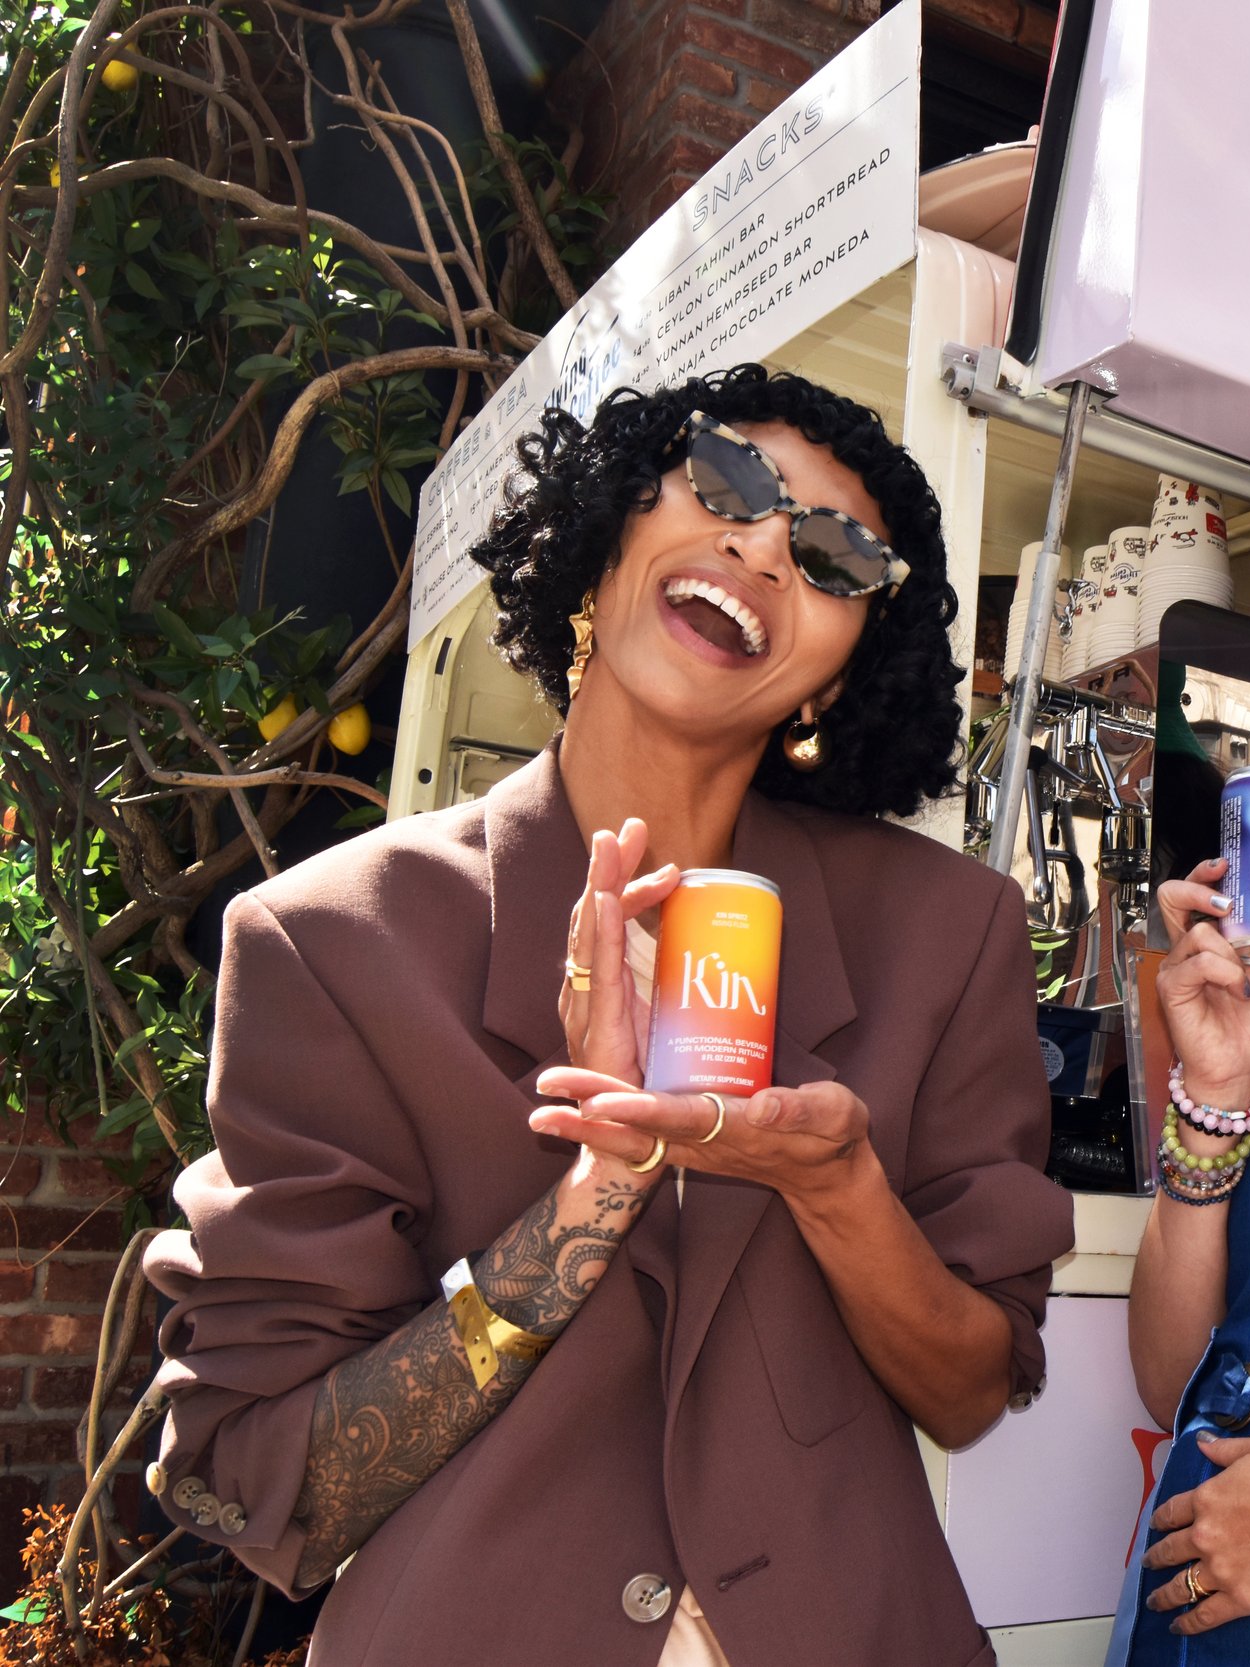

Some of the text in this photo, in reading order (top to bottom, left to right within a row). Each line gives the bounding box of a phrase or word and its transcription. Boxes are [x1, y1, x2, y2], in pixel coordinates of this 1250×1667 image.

[657, 294, 703, 339] CEYLON
[707, 232, 779, 296] CINNAMON
[784, 148, 890, 236] SHORTBREAD
[658, 276, 691, 312] LIBAN
[695, 238, 735, 279] TAHINI
[739, 213, 765, 242] BAR
[655, 229, 870, 393] GUANAJA CHOCOLATE MONEDA
[656, 323, 703, 367] YUNNAN
[706, 263, 778, 327] HEMPSEED
[784, 237, 812, 267] BAR
[428, 427, 481, 507] COFFEE
[497, 377, 528, 425] TEA
[679, 950, 766, 1016] Kin
[675, 1036, 733, 1045] FUNCTIONAL
[735, 1039, 768, 1052] BEVERAGE
[675, 1045, 765, 1059] FOR MODERN RITUALS
[689, 1074, 754, 1087] DIETARY SUPPLEMENT
